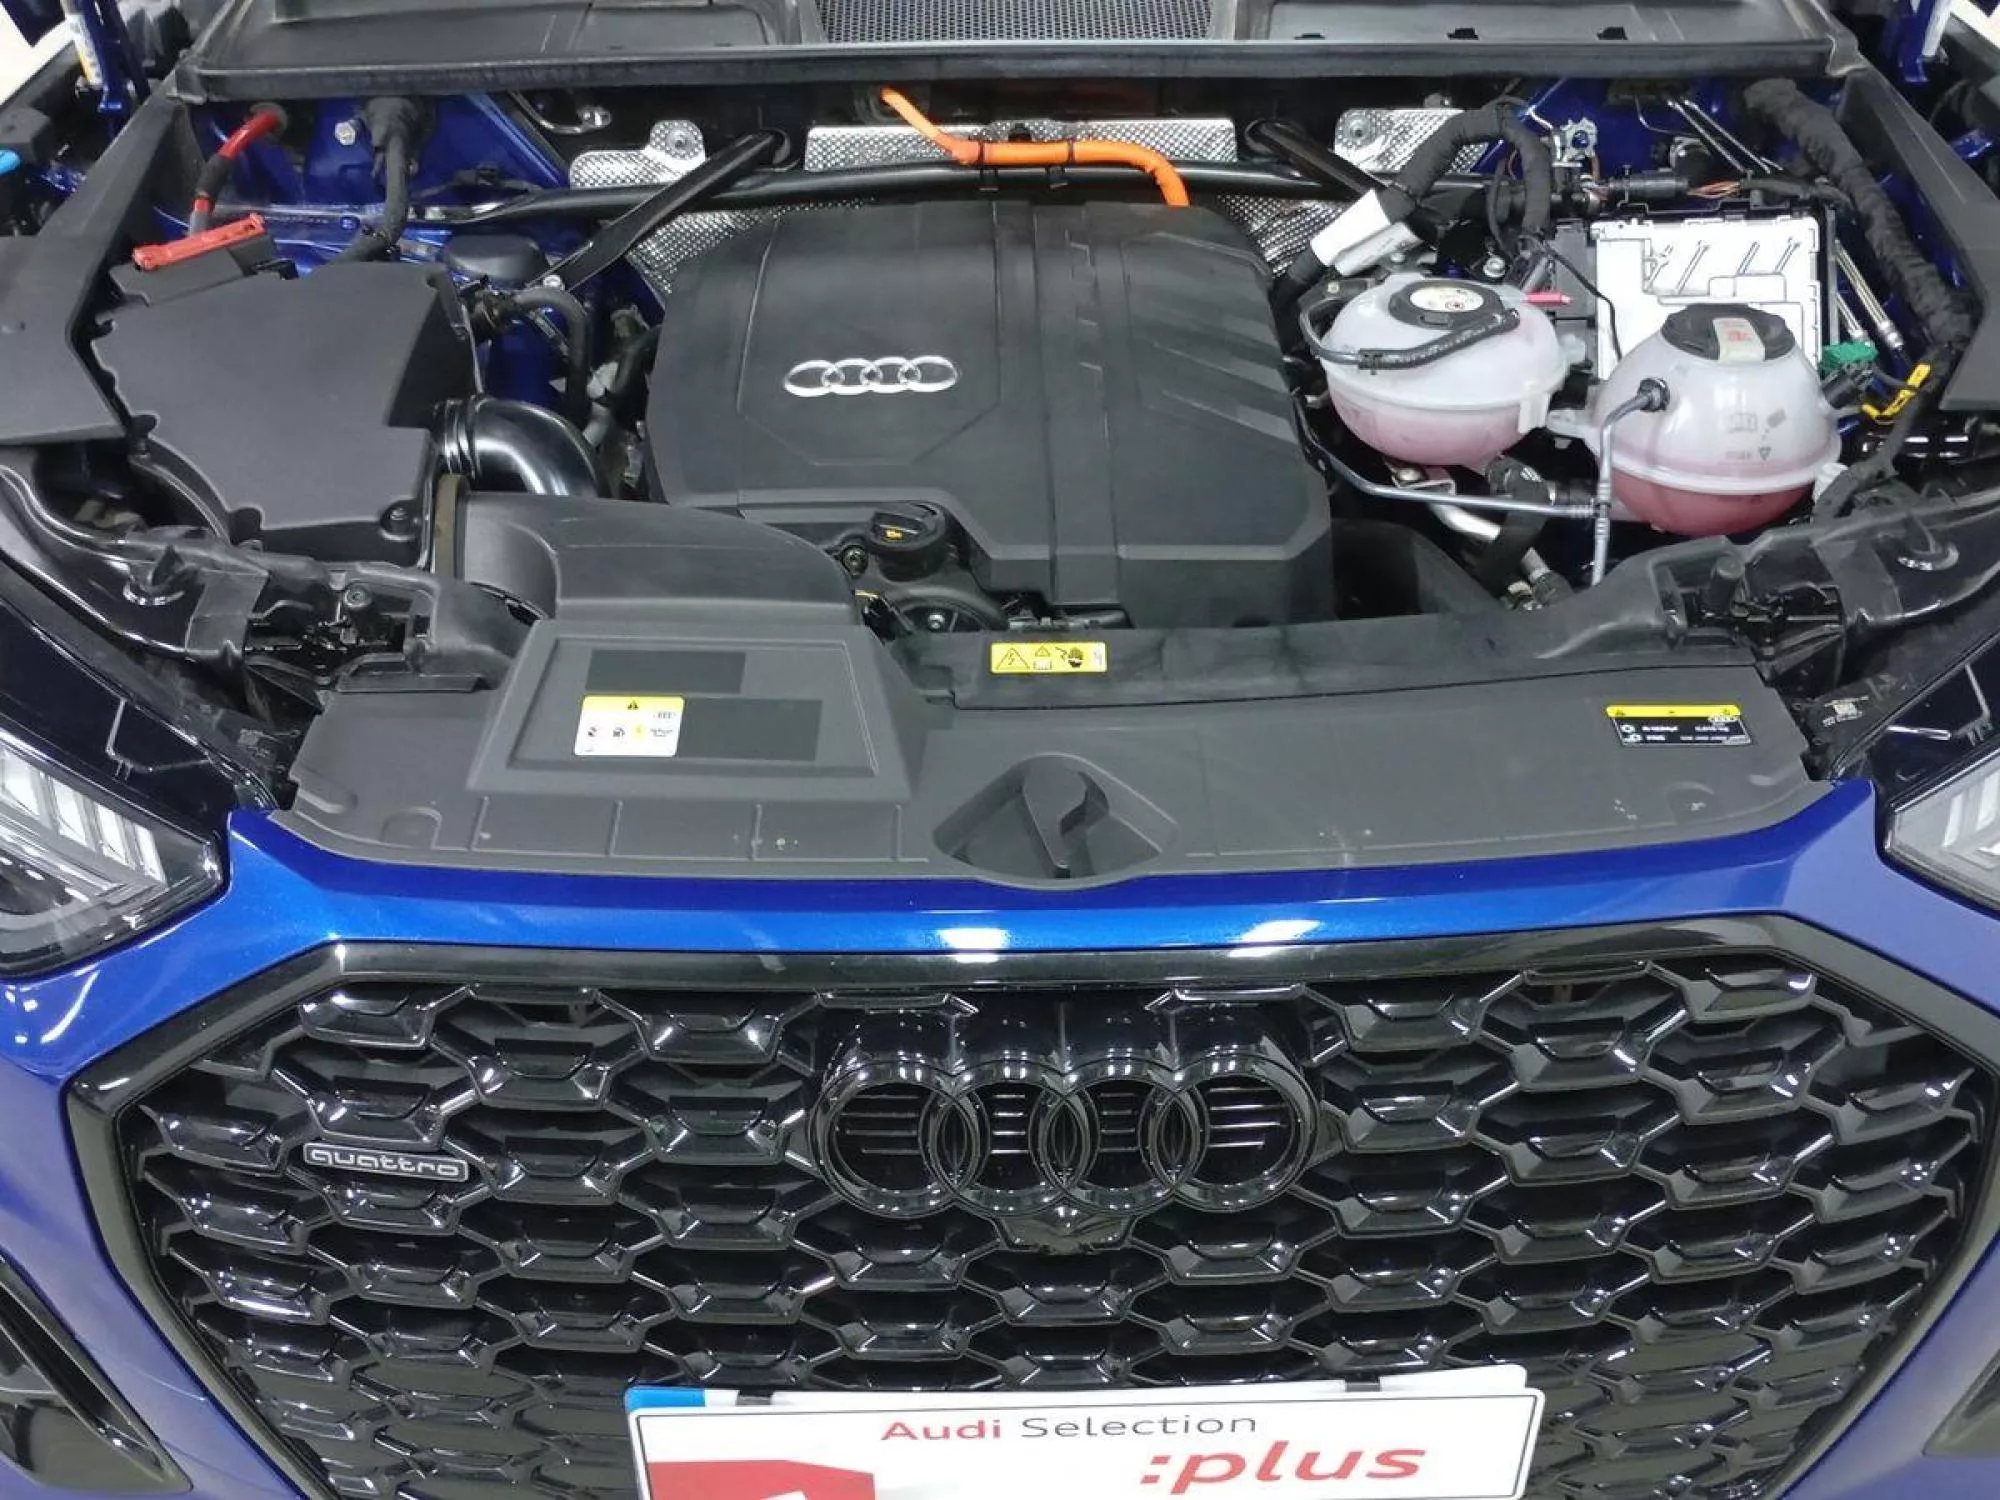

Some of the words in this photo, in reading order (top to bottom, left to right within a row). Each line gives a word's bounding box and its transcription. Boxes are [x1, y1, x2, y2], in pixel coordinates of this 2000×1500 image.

[309, 1148, 460, 1177] quattro
[880, 1418, 1001, 1441] Audi
[1020, 1413, 1258, 1438] Selection
